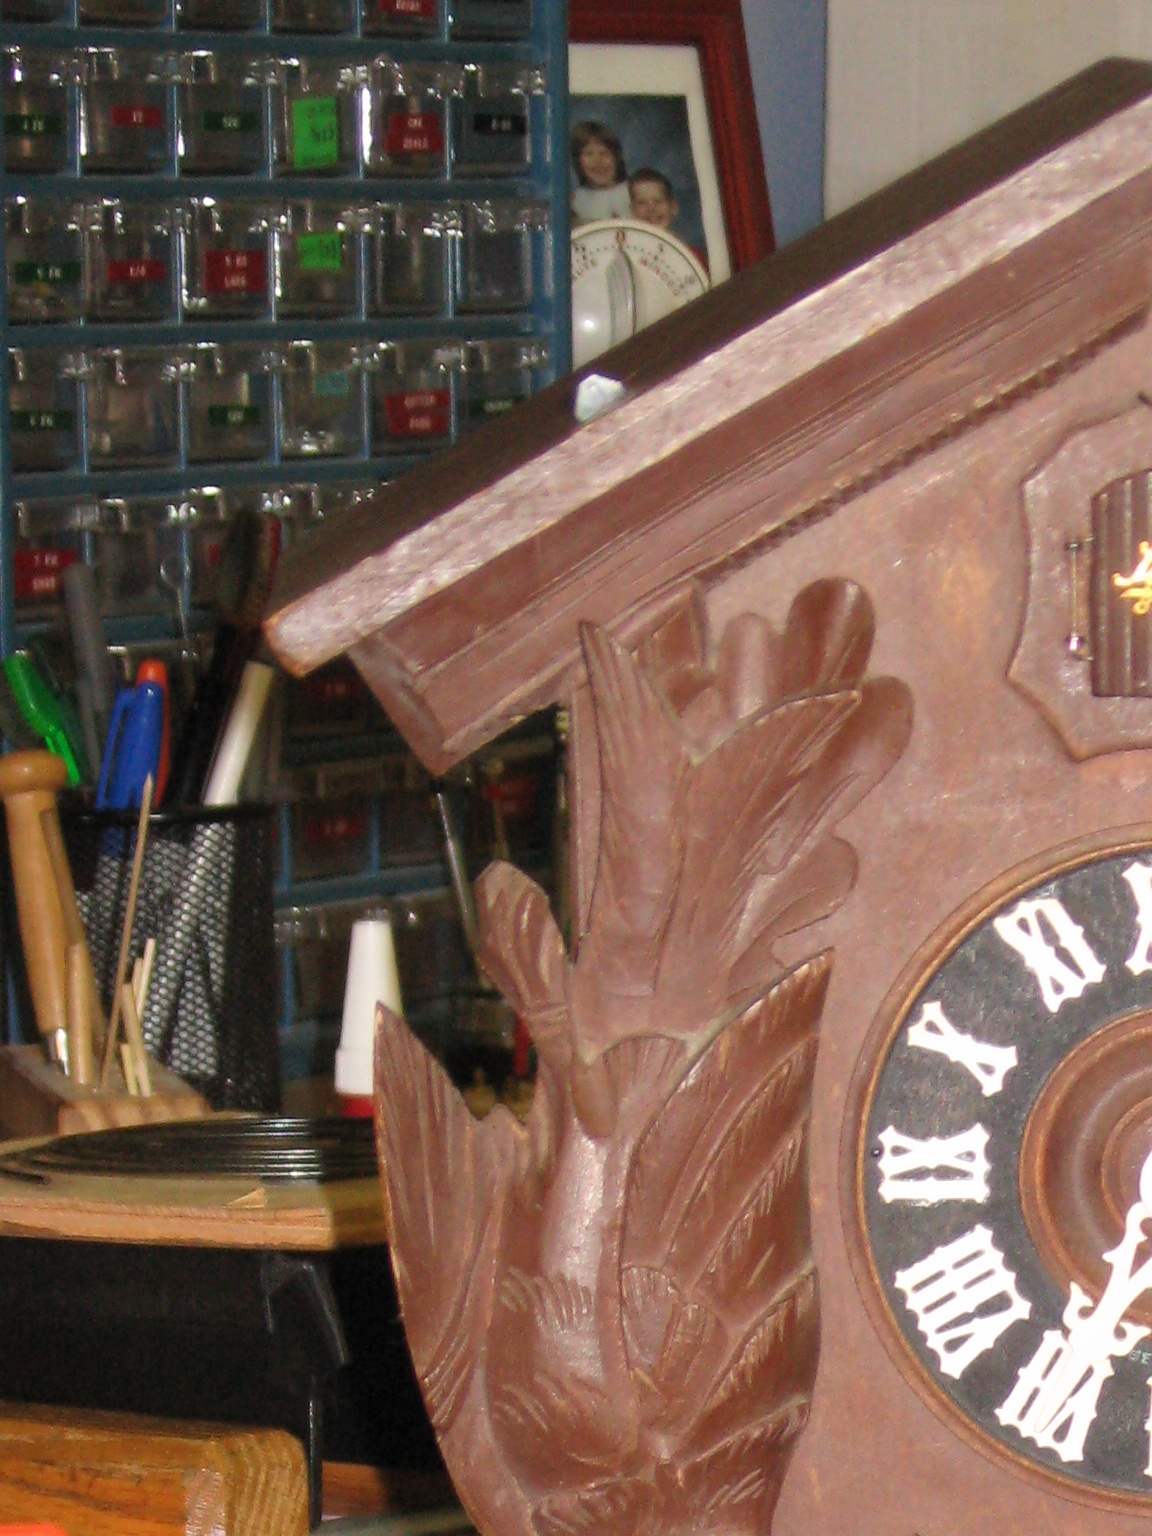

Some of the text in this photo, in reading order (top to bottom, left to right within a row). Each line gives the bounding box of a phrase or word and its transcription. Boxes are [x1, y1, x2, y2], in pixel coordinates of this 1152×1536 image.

[993, 897, 1107, 1013] XI
[907, 1001, 1018, 1097] X
[878, 1122, 992, 1204] IX
[894, 1223, 1032, 1379] VIII
